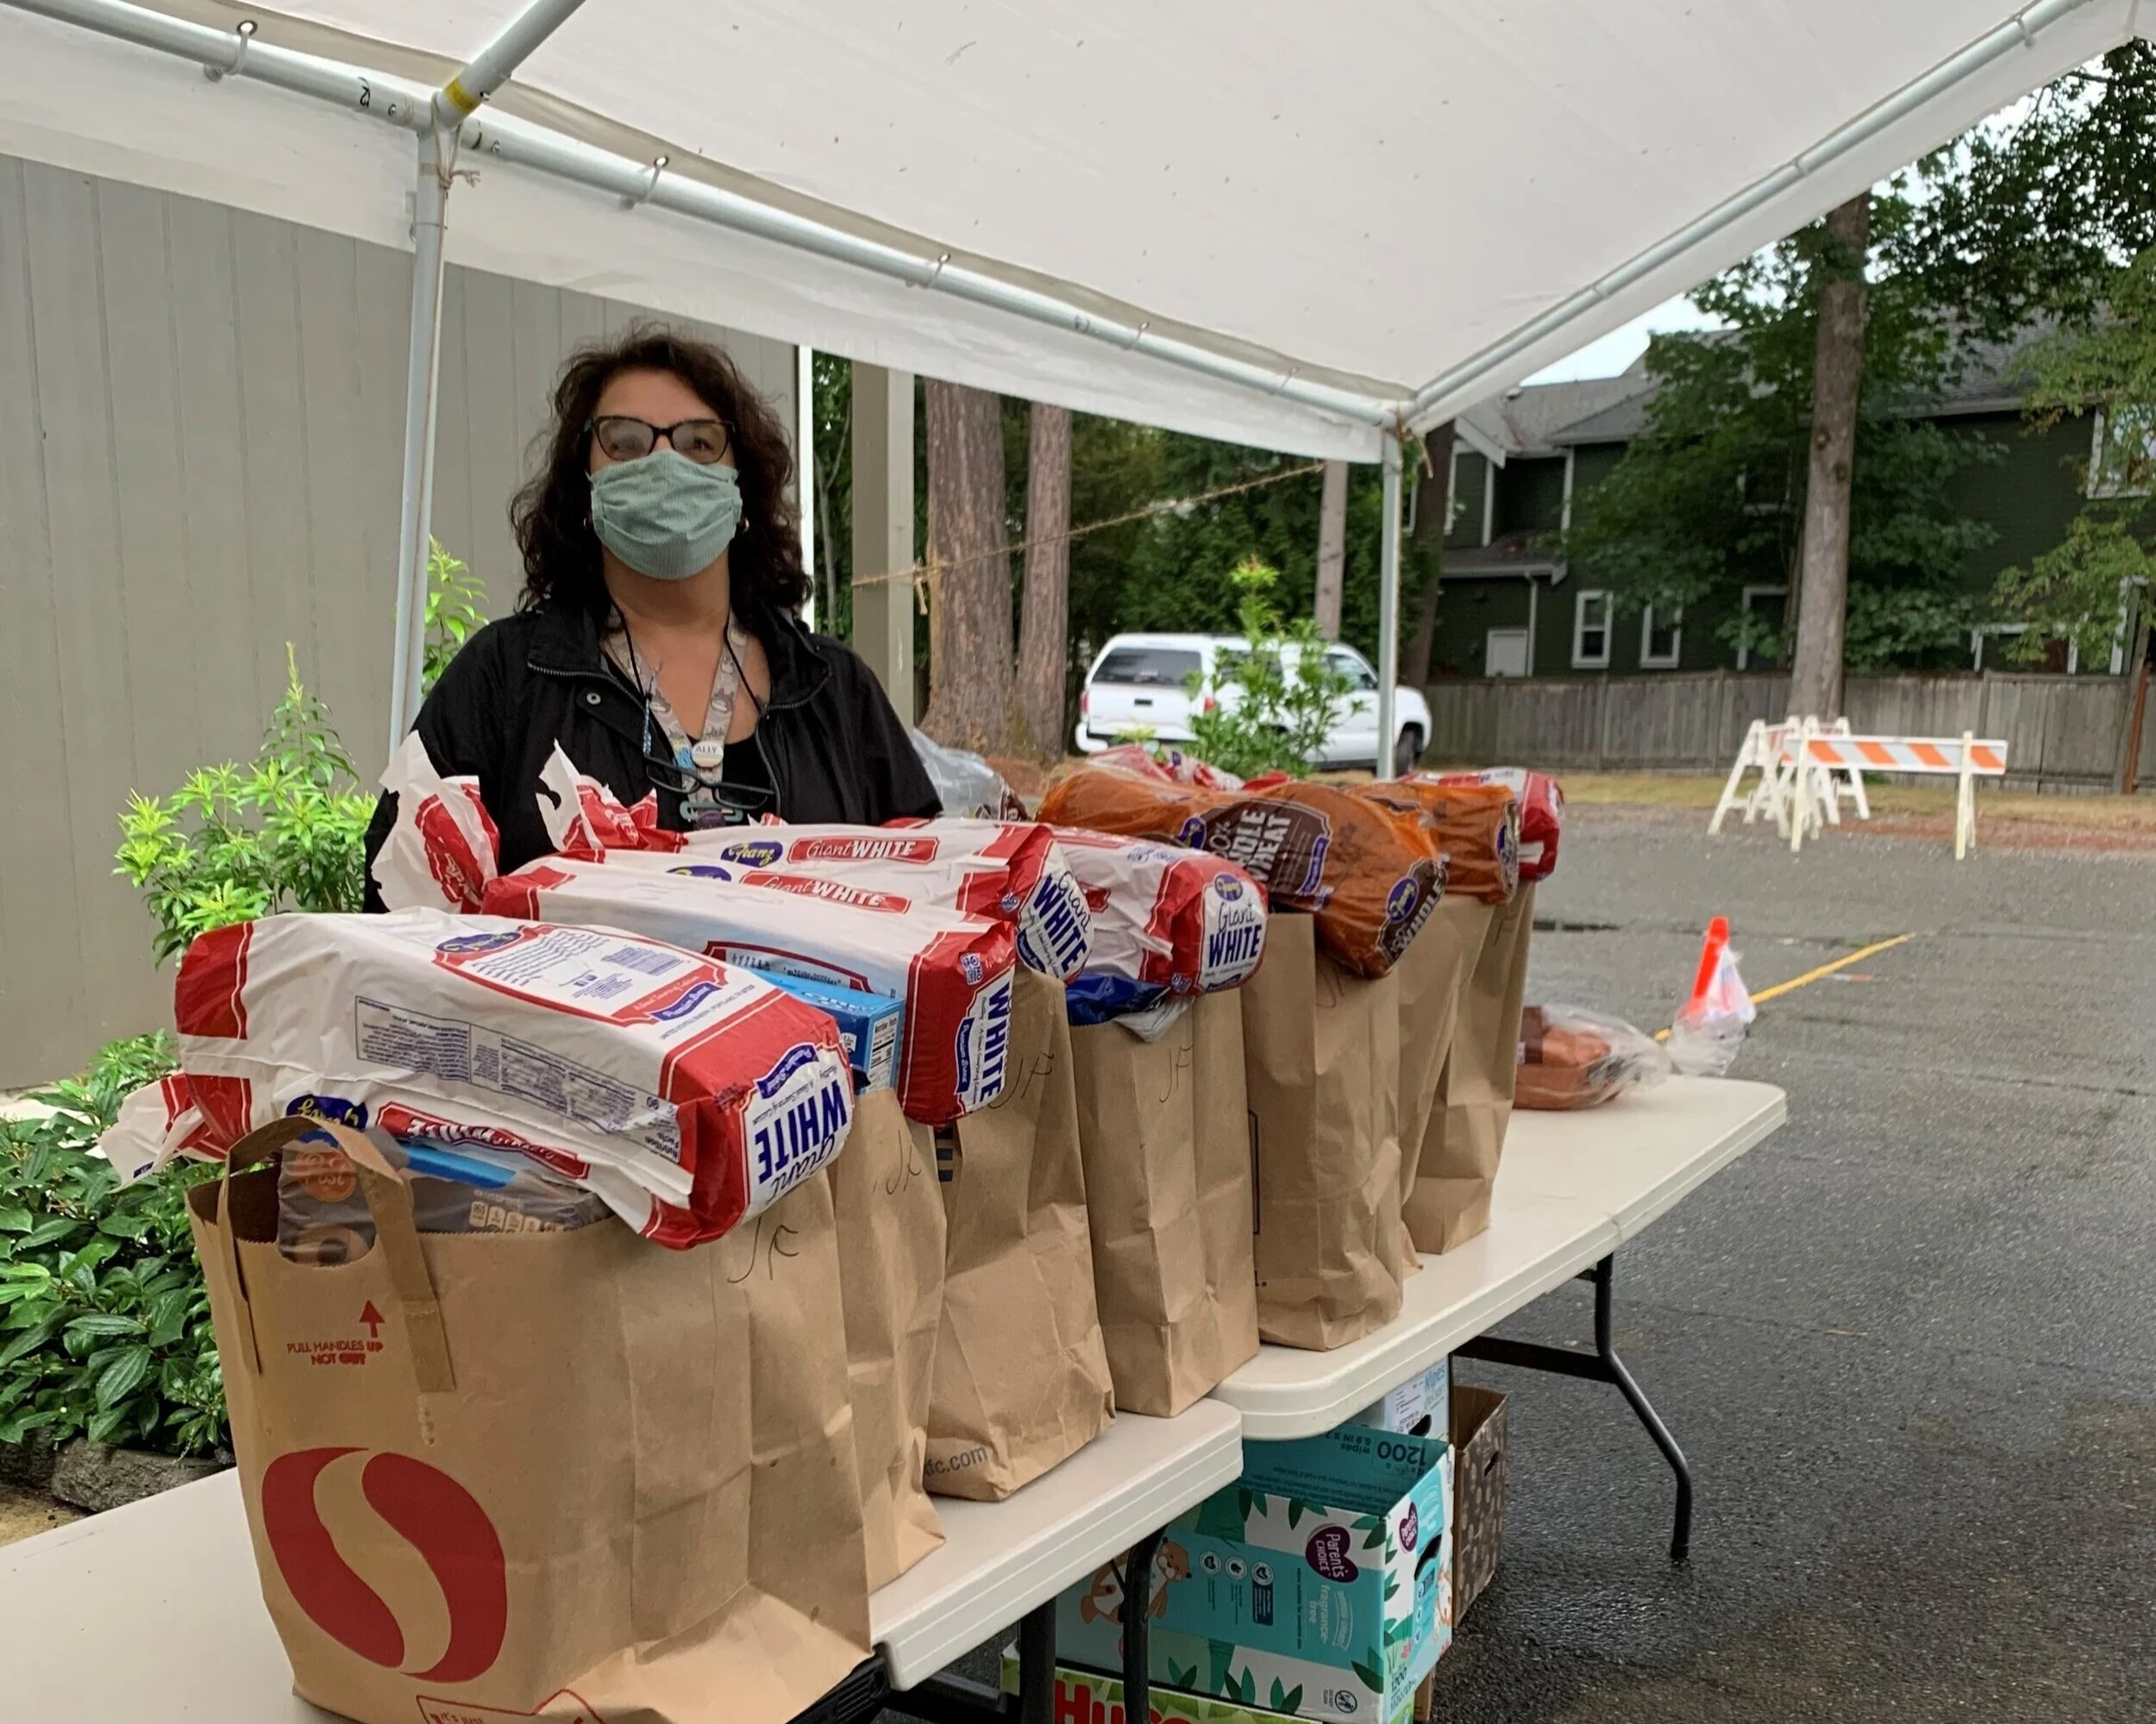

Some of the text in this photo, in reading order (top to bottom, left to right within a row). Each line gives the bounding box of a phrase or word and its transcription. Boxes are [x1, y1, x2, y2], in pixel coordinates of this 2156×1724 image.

[696, 744, 718, 755] ALLY
[807, 837, 917, 859] Giant WHITE
[1229, 809, 1267, 868] HOLE
[812, 881, 887, 906] WHITE
[1058, 871, 1090, 933] Giant
[1033, 873, 1088, 974] WHITE
[1219, 900, 1256, 932] Giant
[1208, 924, 1262, 968] WHITE
[980, 980, 1011, 1103] WHITE
[755, 1080, 848, 1185] WHITE
[766, 1133, 836, 1207] Giant
[286, 1343, 311, 1354] PULL
[312, 1340, 366, 1353] HANDLES
[310, 1353, 337, 1365] NOT
[1377, 1441, 1427, 1466] 1200
[1316, 1539, 1326, 1572] CHOICE
[1326, 1533, 1349, 1578] Parent's
